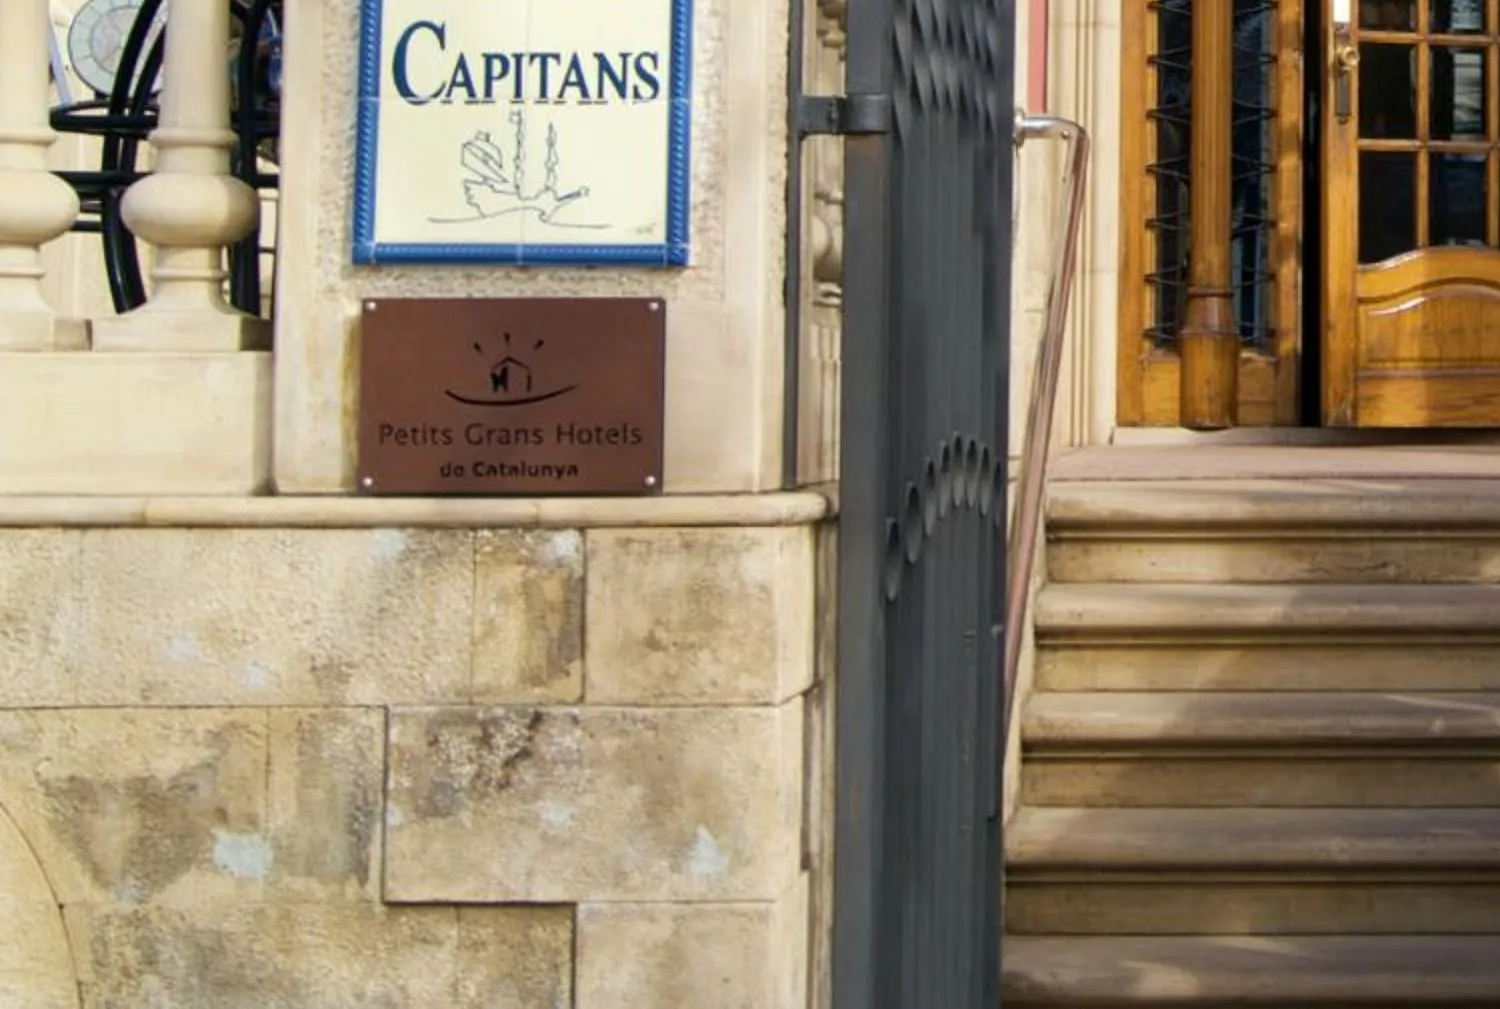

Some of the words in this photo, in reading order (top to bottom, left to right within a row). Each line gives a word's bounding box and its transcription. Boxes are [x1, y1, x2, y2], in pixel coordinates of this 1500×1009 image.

[392, 20, 662, 107] CAPITANS
[379, 423, 453, 446] Petits
[464, 423, 545, 446] Grans
[556, 423, 643, 446] Hotels
[440, 461, 465, 478] de
[472, 461, 579, 480] Catalunya
